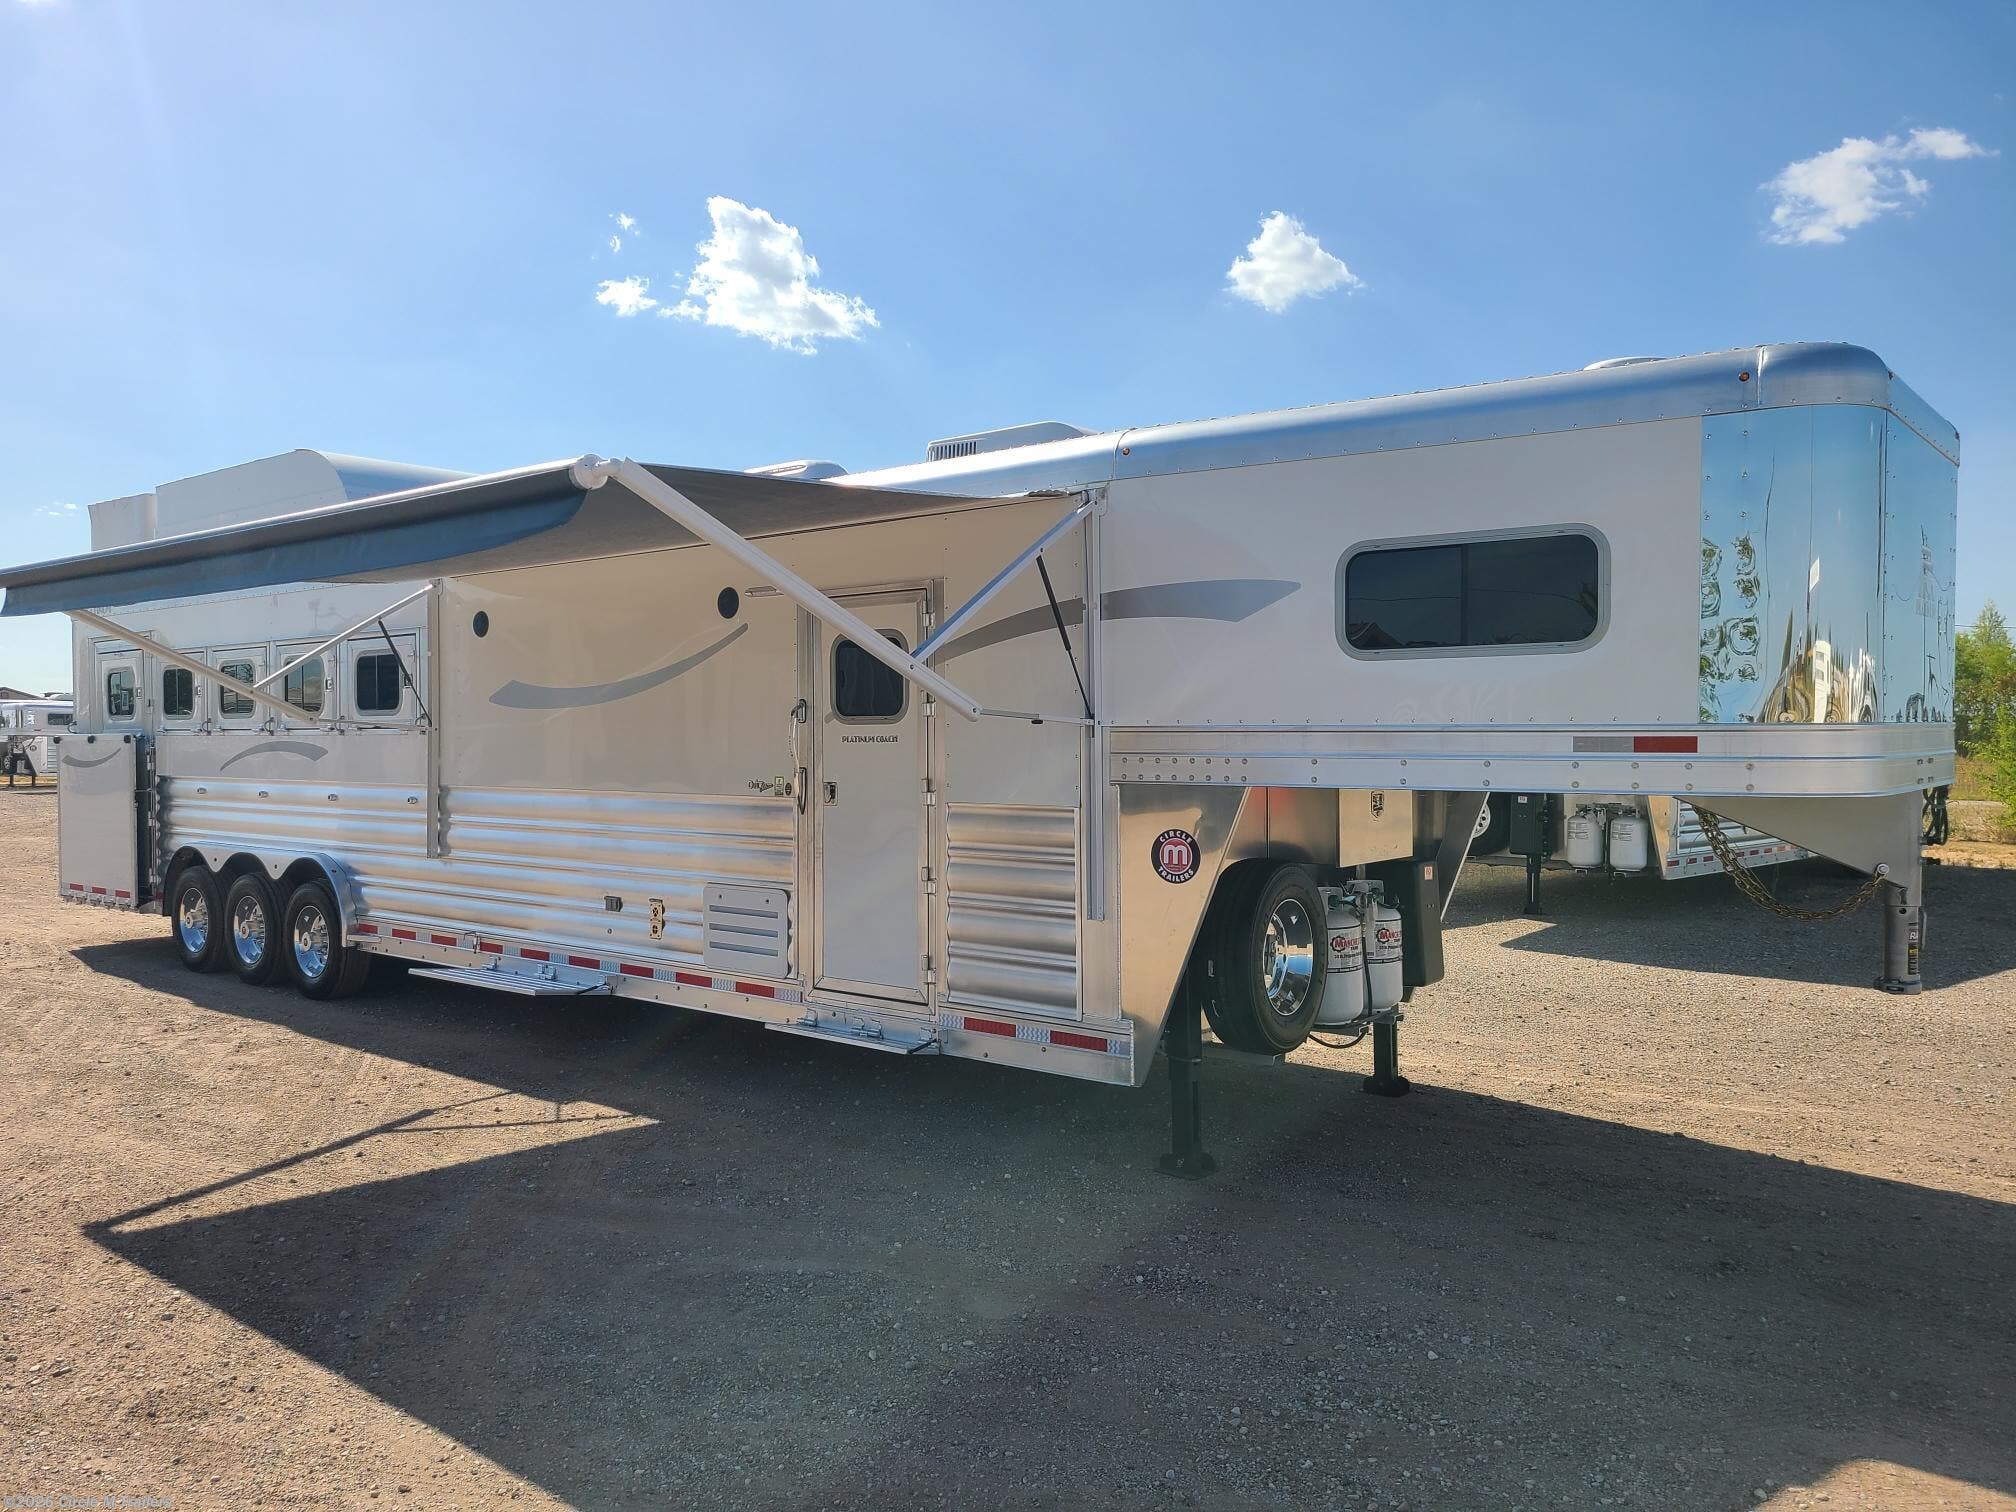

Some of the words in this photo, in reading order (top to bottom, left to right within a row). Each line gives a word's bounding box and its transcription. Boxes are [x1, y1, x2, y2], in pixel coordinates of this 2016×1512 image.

[841, 735, 876, 743] PLATINUM
[1159, 830, 1193, 844] CIRCLE
[1158, 867, 1194, 882] TRAILERS
